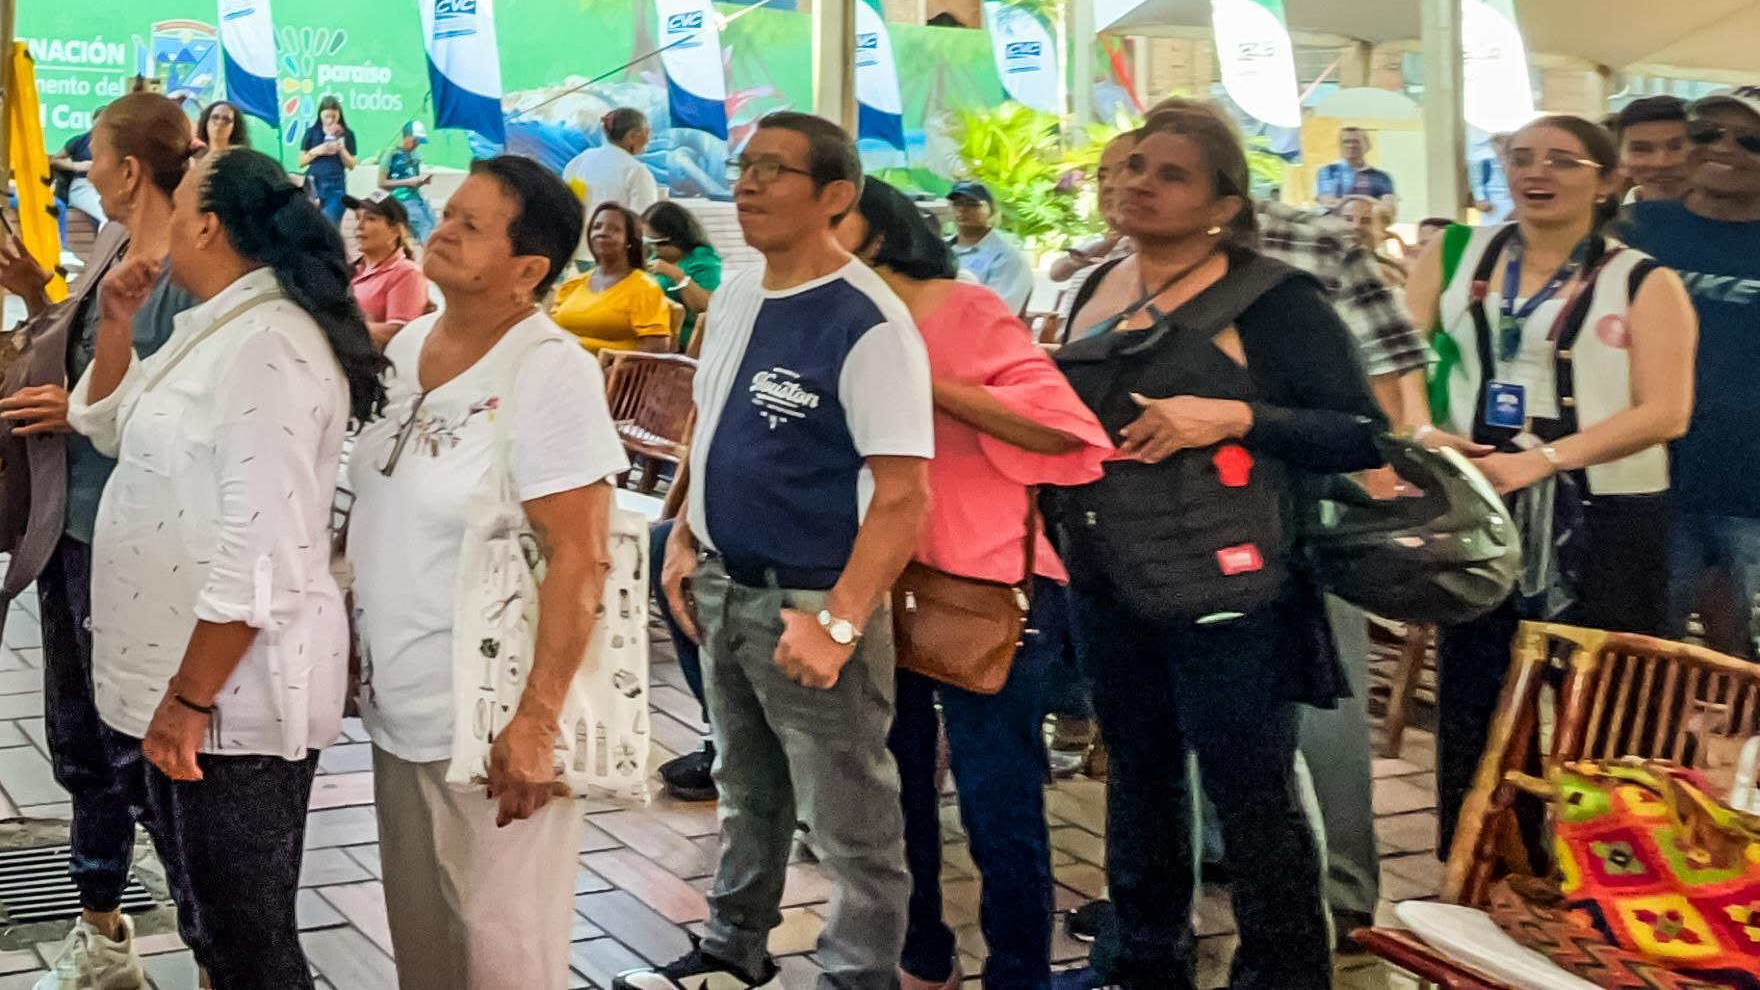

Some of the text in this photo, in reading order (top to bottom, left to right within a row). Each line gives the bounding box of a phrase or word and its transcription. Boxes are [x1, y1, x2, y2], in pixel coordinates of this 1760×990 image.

[317, 60, 391, 87] paraíso
[96, 76, 124, 97] del
[350, 86, 403, 111] todos
